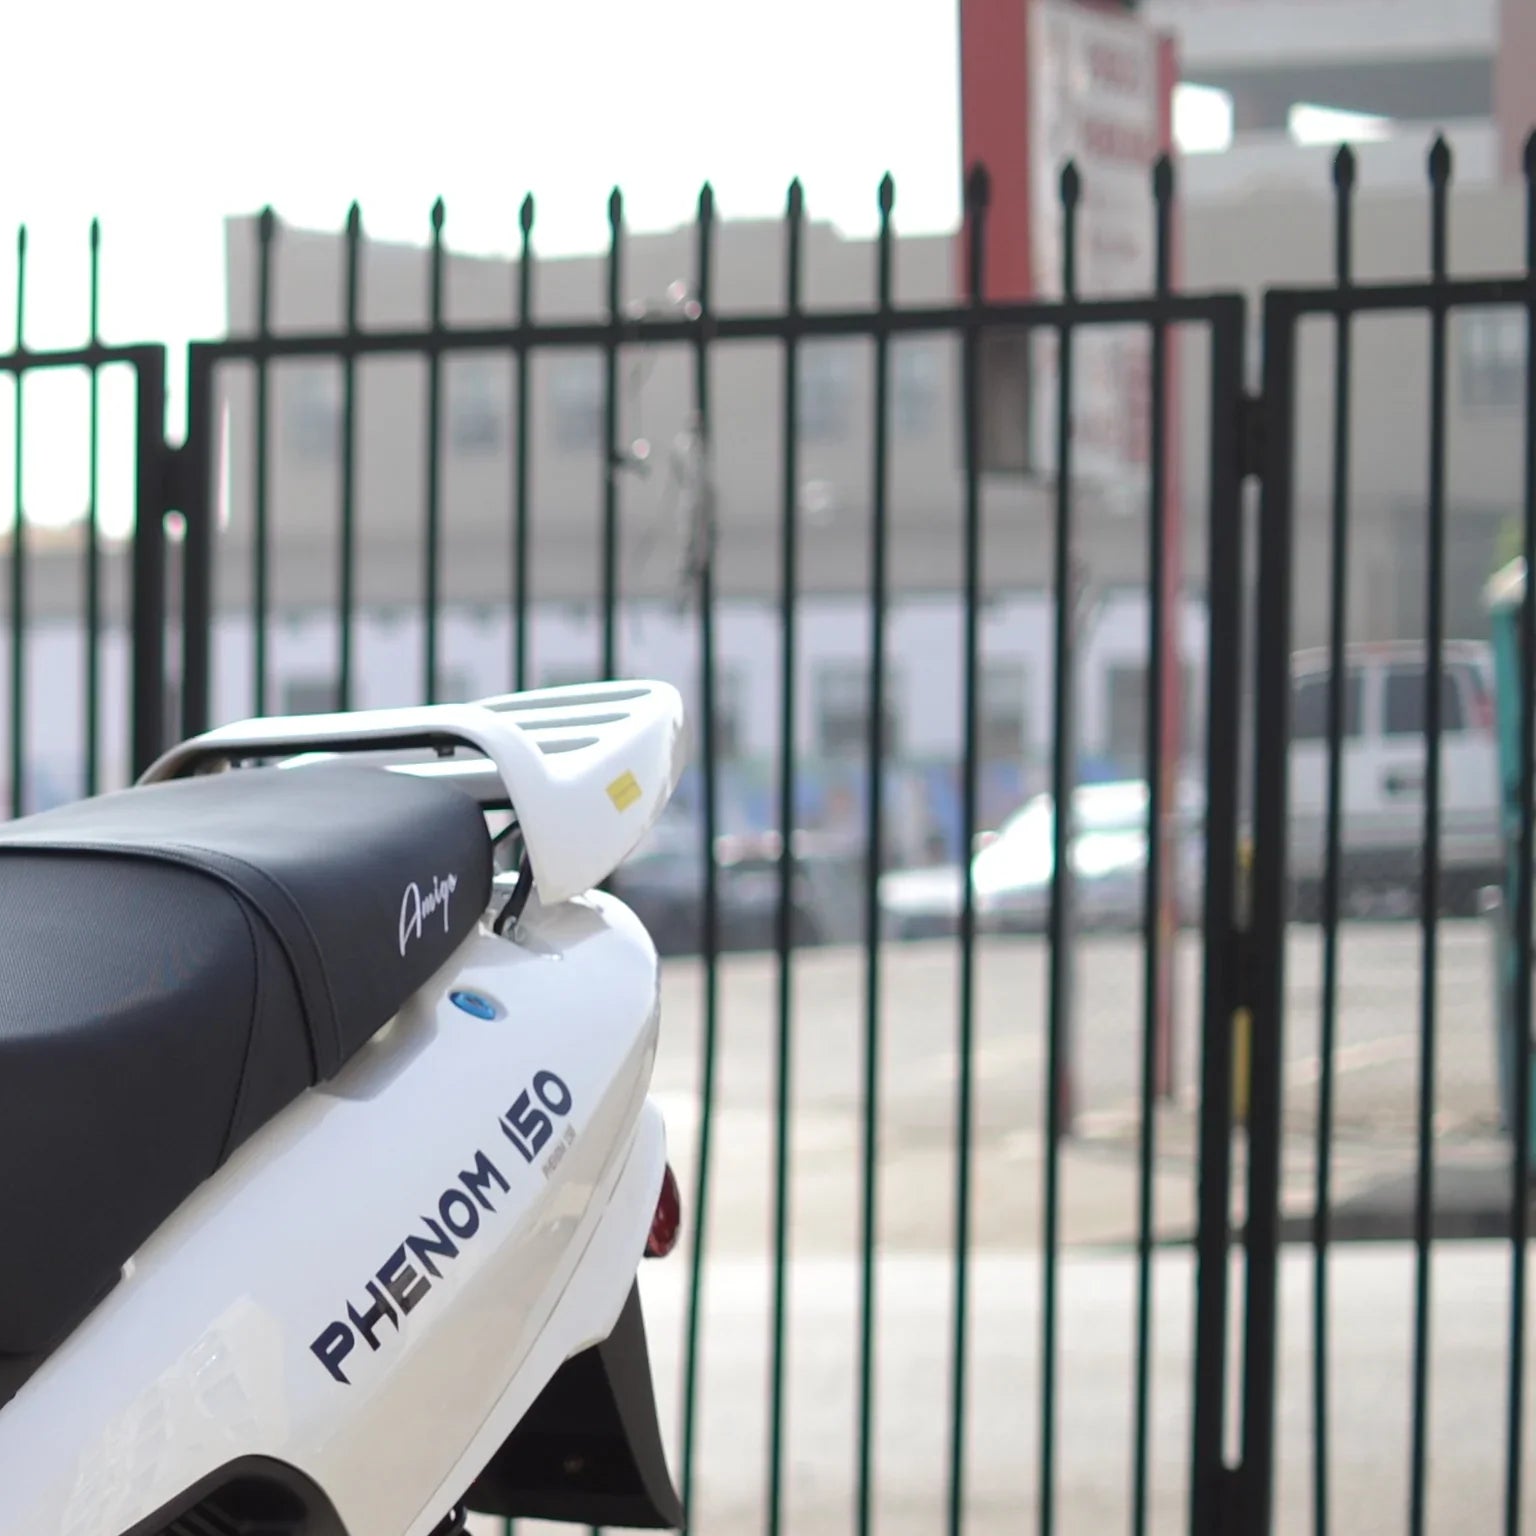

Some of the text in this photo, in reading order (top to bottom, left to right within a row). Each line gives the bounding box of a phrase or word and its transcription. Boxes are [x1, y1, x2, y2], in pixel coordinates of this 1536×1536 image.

[398, 872, 458, 957] Amigo
[309, 1070, 573, 1386] PHENOM 150
